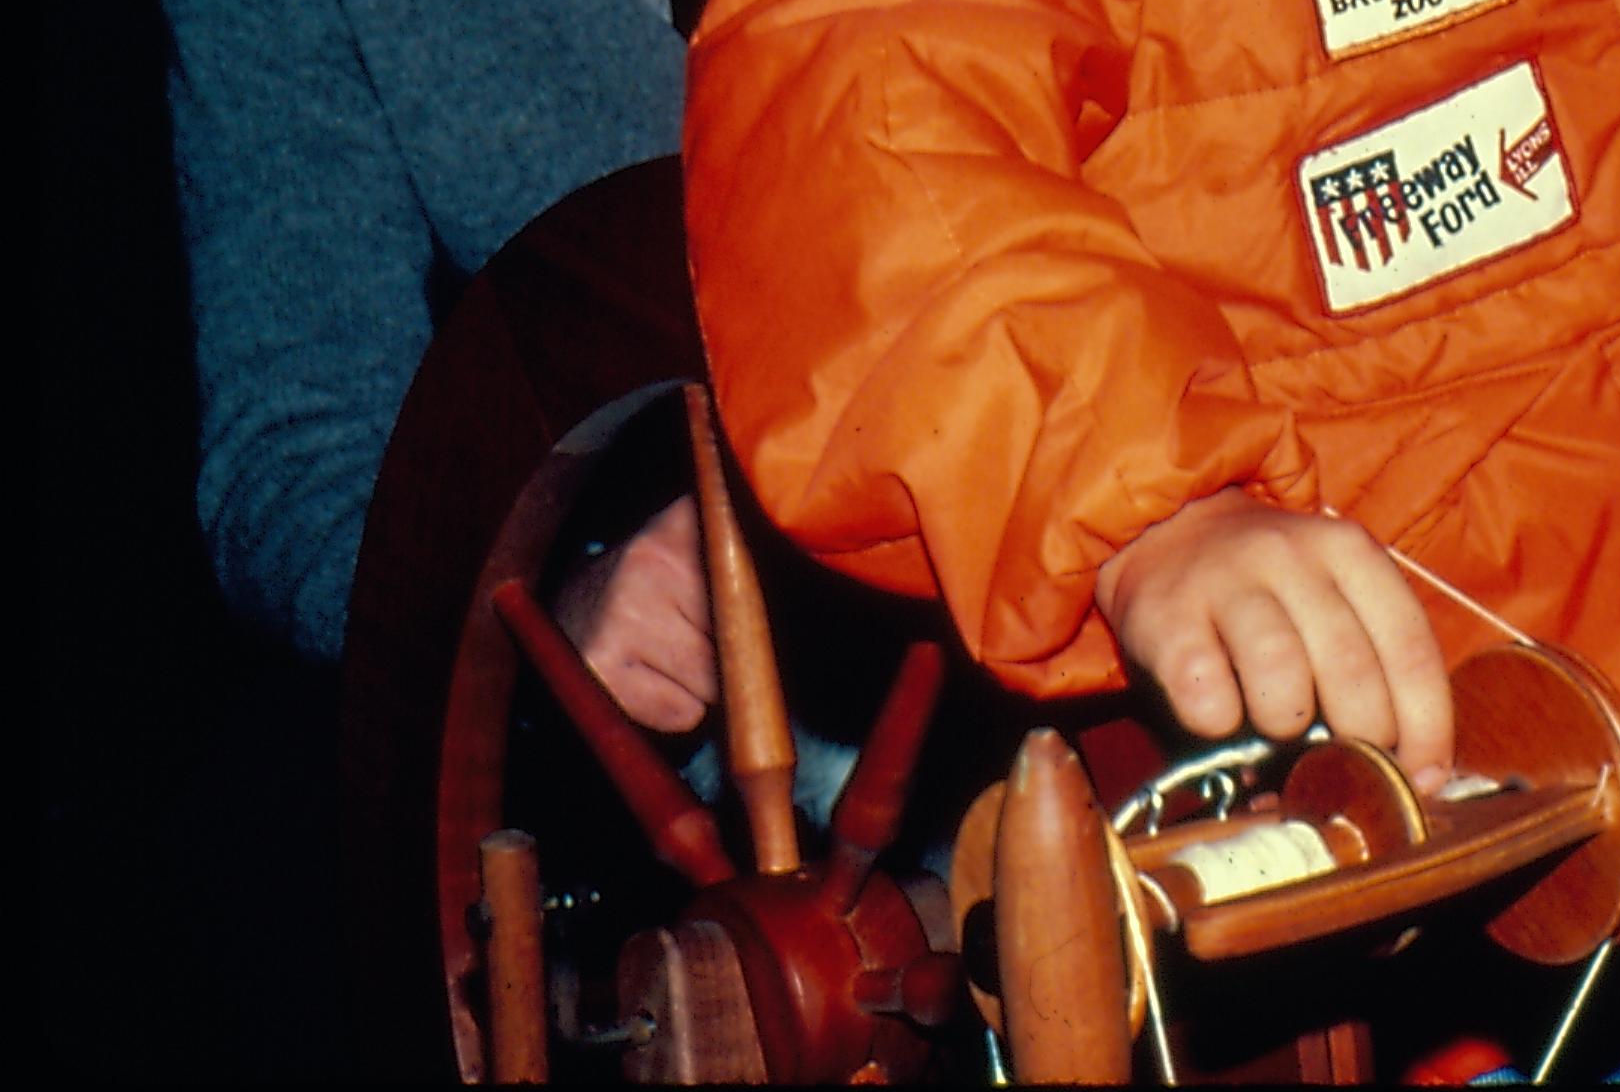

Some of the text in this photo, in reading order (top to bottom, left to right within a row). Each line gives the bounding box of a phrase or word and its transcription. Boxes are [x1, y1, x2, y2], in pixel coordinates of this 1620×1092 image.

[1504, 120, 1552, 176] LYONS
[1511, 156, 1538, 186] ILL
[1338, 134, 1482, 251] Freeway
[1419, 170, 1502, 250] Ford
